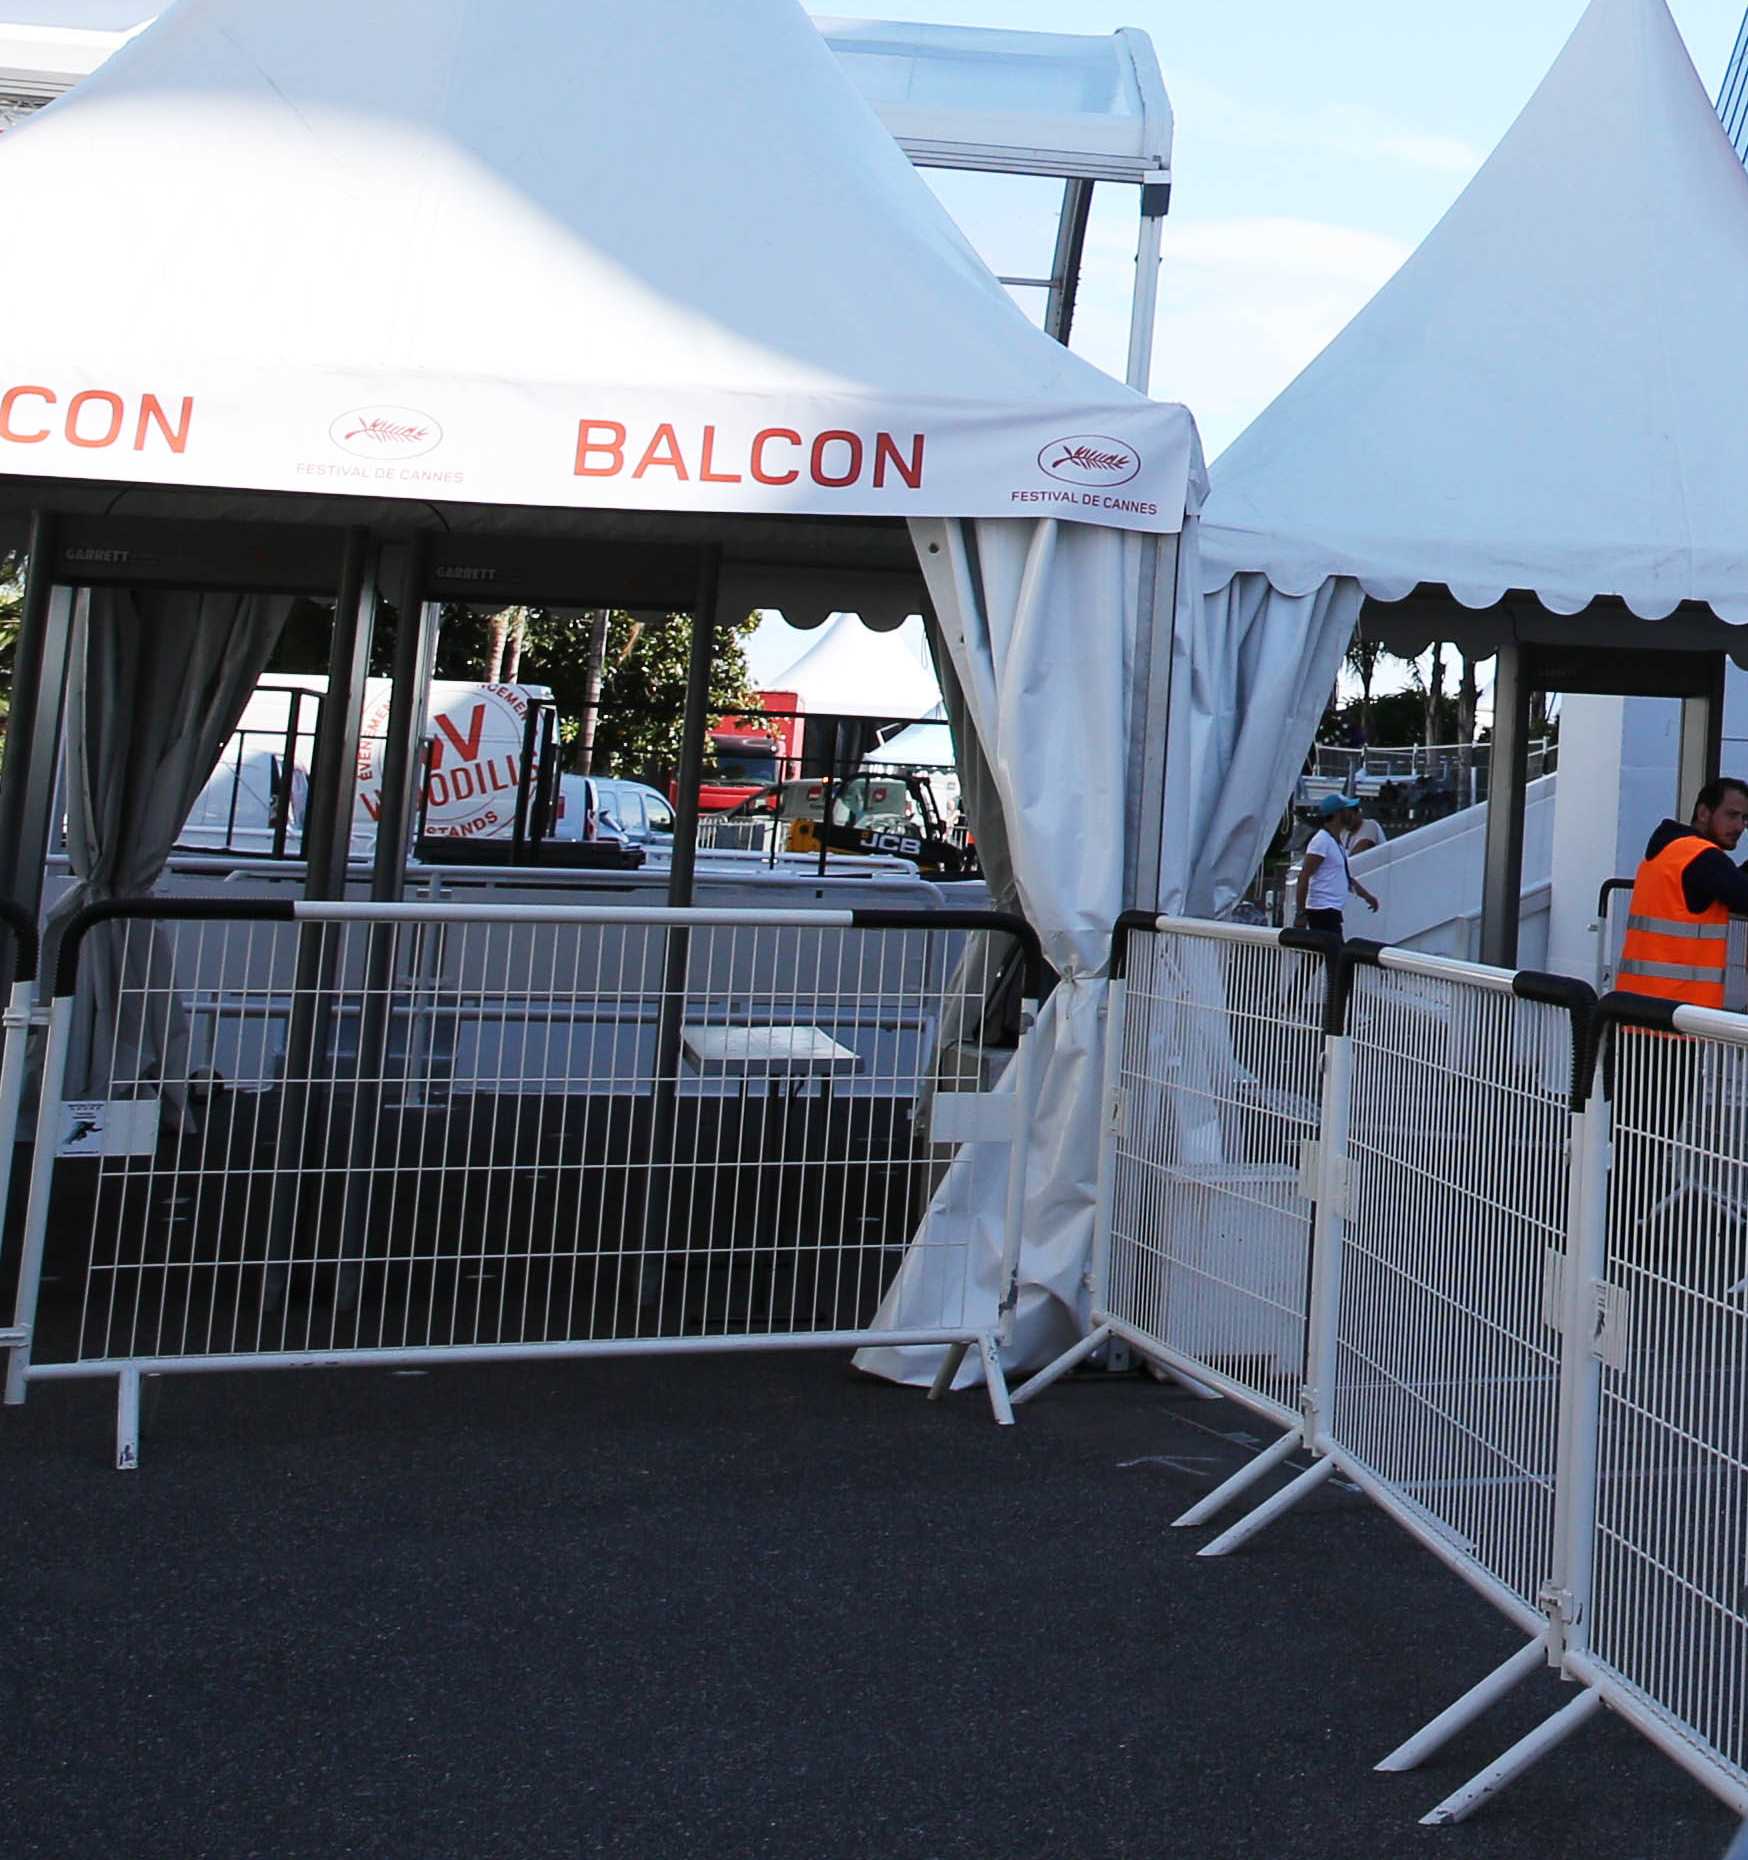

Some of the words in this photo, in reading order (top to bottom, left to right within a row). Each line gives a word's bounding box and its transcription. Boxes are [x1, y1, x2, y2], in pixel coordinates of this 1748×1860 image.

[573, 418, 925, 489] BALCON
[296, 462, 369, 480] FESTIVAL
[374, 466, 396, 480] DE
[400, 468, 464, 484] CANNES
[1011, 490, 1079, 504] FESTIVAL
[1082, 494, 1100, 507] DE
[1103, 497, 1158, 515] CANNES
[65, 547, 129, 564] GARRETT
[860, 833, 921, 855] JCB
